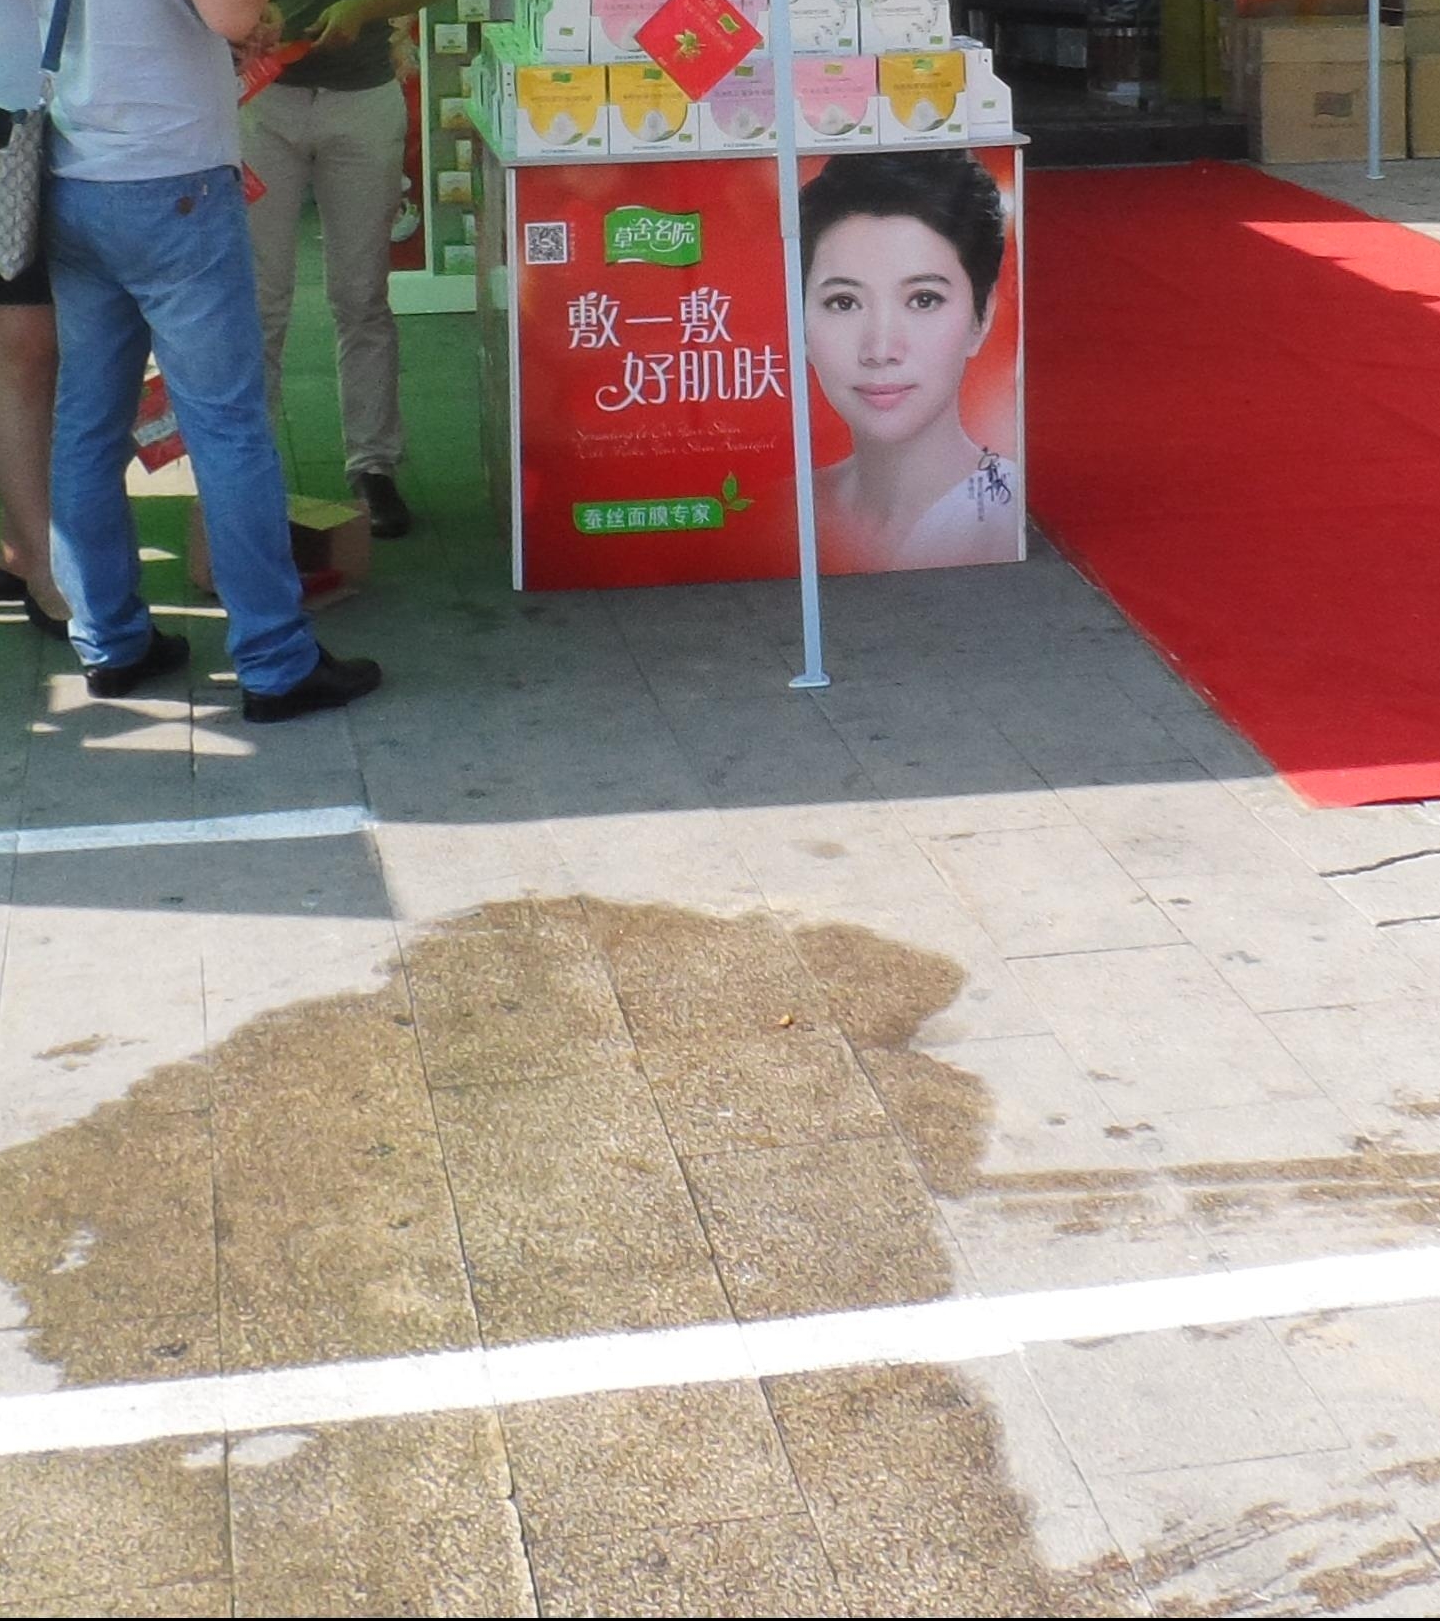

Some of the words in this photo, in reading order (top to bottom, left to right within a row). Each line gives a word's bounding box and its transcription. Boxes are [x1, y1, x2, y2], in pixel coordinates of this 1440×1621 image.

[613, 216, 696, 253] 草舍名院
[566, 286, 733, 349] 敷一敷
[594, 344, 788, 412] 好肌肤
[583, 502, 711, 530] 蚕丝面膜专家
